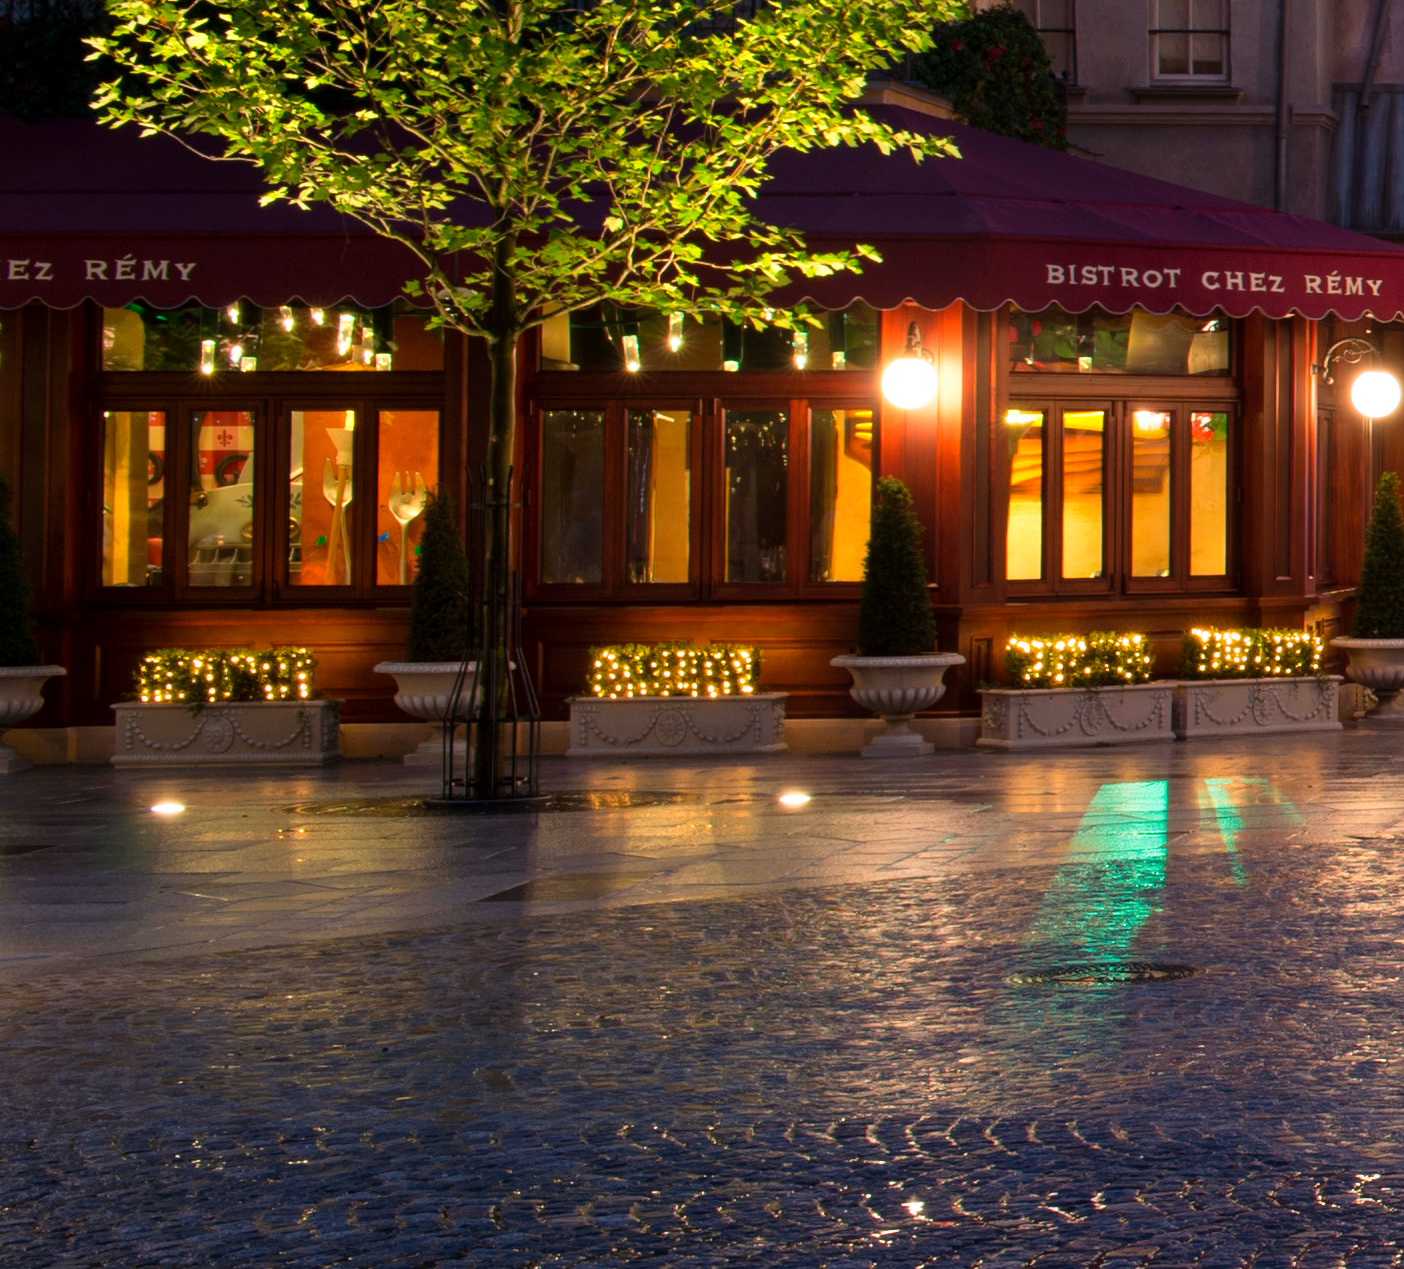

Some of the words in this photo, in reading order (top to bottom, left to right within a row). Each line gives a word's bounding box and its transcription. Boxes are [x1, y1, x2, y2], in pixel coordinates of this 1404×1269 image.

[0, 258, 54, 281] EZ
[83, 253, 198, 281] RÉMY
[1045, 264, 1182, 288] BISTROT
[1201, 271, 1286, 294] CHEZ
[1303, 270, 1384, 297] RÉMY
